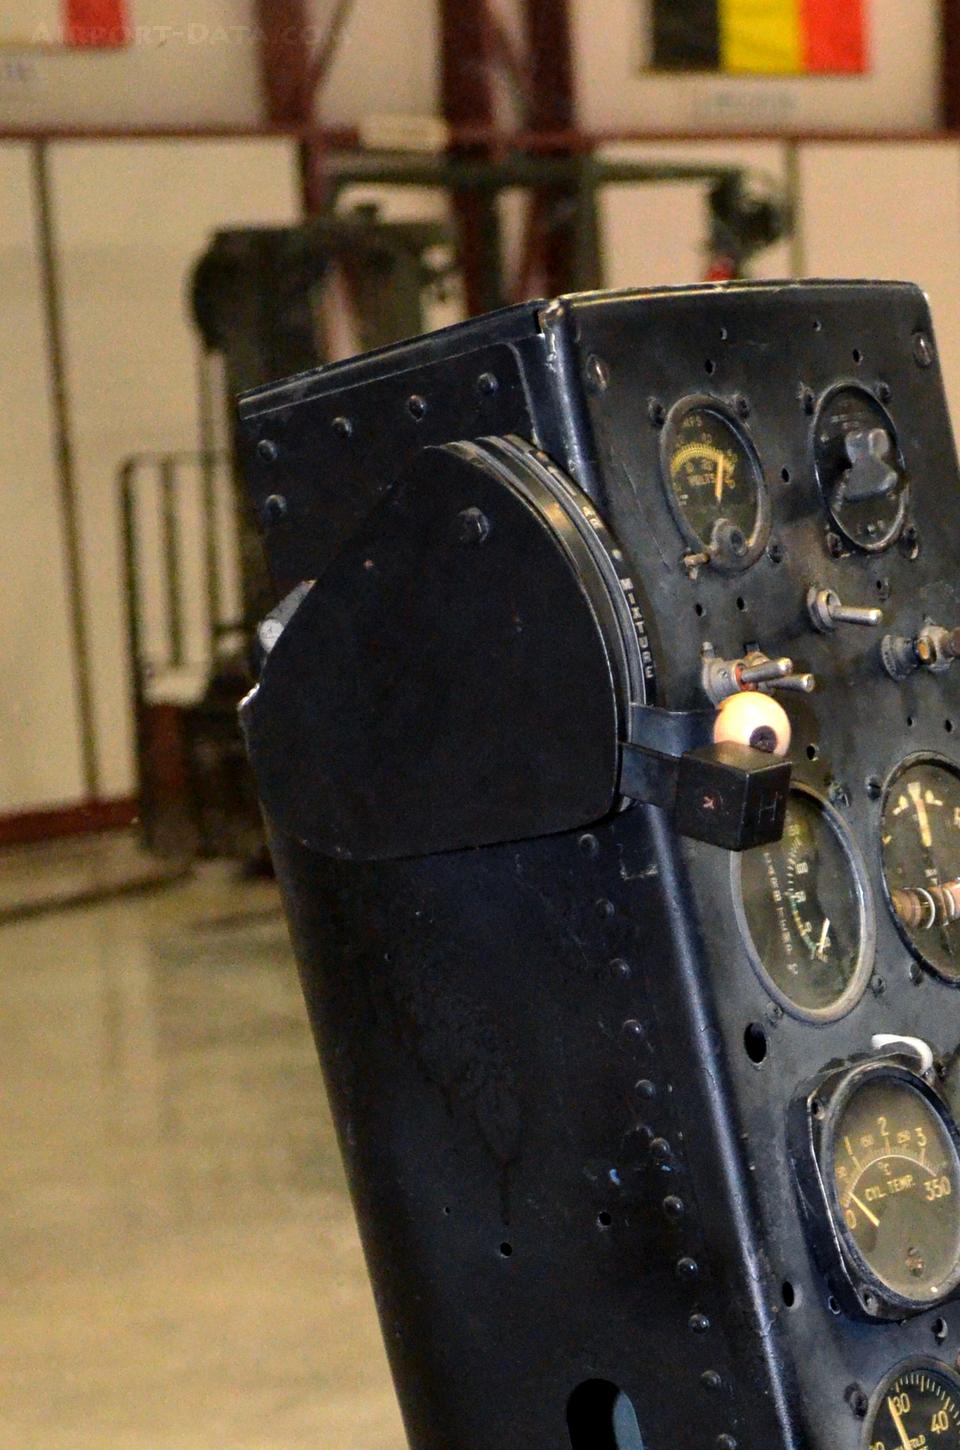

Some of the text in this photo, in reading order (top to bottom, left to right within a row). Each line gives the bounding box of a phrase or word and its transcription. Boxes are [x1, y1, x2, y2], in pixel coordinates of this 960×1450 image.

[620, 577, 654, 679] MIXTURE
[878, 1116, 889, 1137] 2
[914, 1127, 928, 1147] 3
[924, 1176, 951, 1201] 350
[892, 1392, 911, 1417] 30
[930, 1409, 949, 1434] 40
